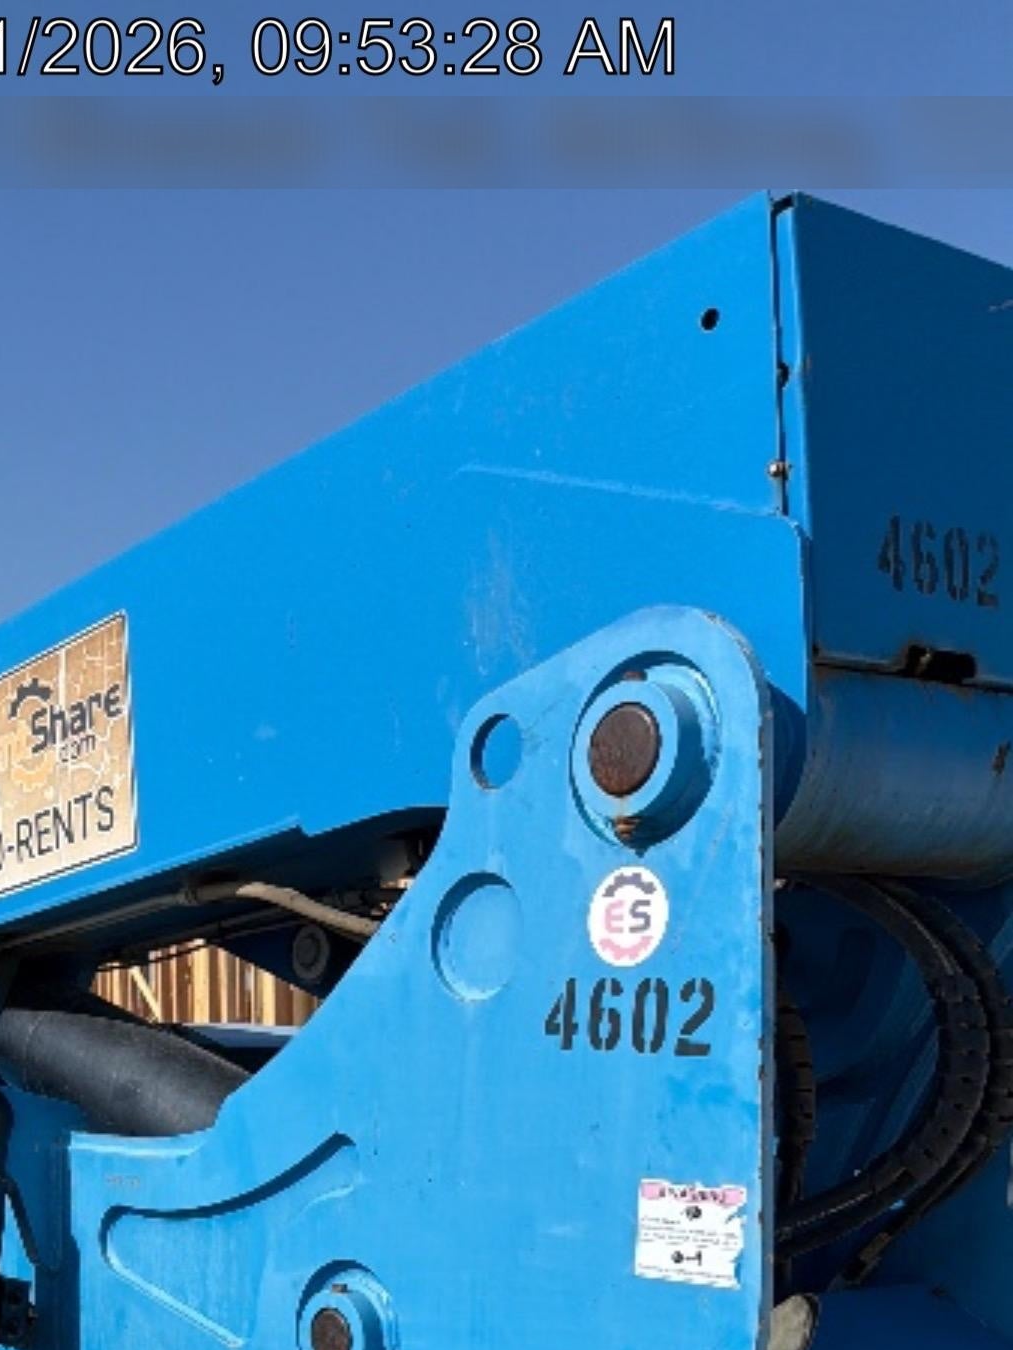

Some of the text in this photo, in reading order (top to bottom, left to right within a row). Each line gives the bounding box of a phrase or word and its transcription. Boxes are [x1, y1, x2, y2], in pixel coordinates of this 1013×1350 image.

[877, 514, 1000, 607] 4602
[30, 682, 124, 755] Share
[604, 899, 652, 934] ES
[544, 976, 715, 1057] 4602
